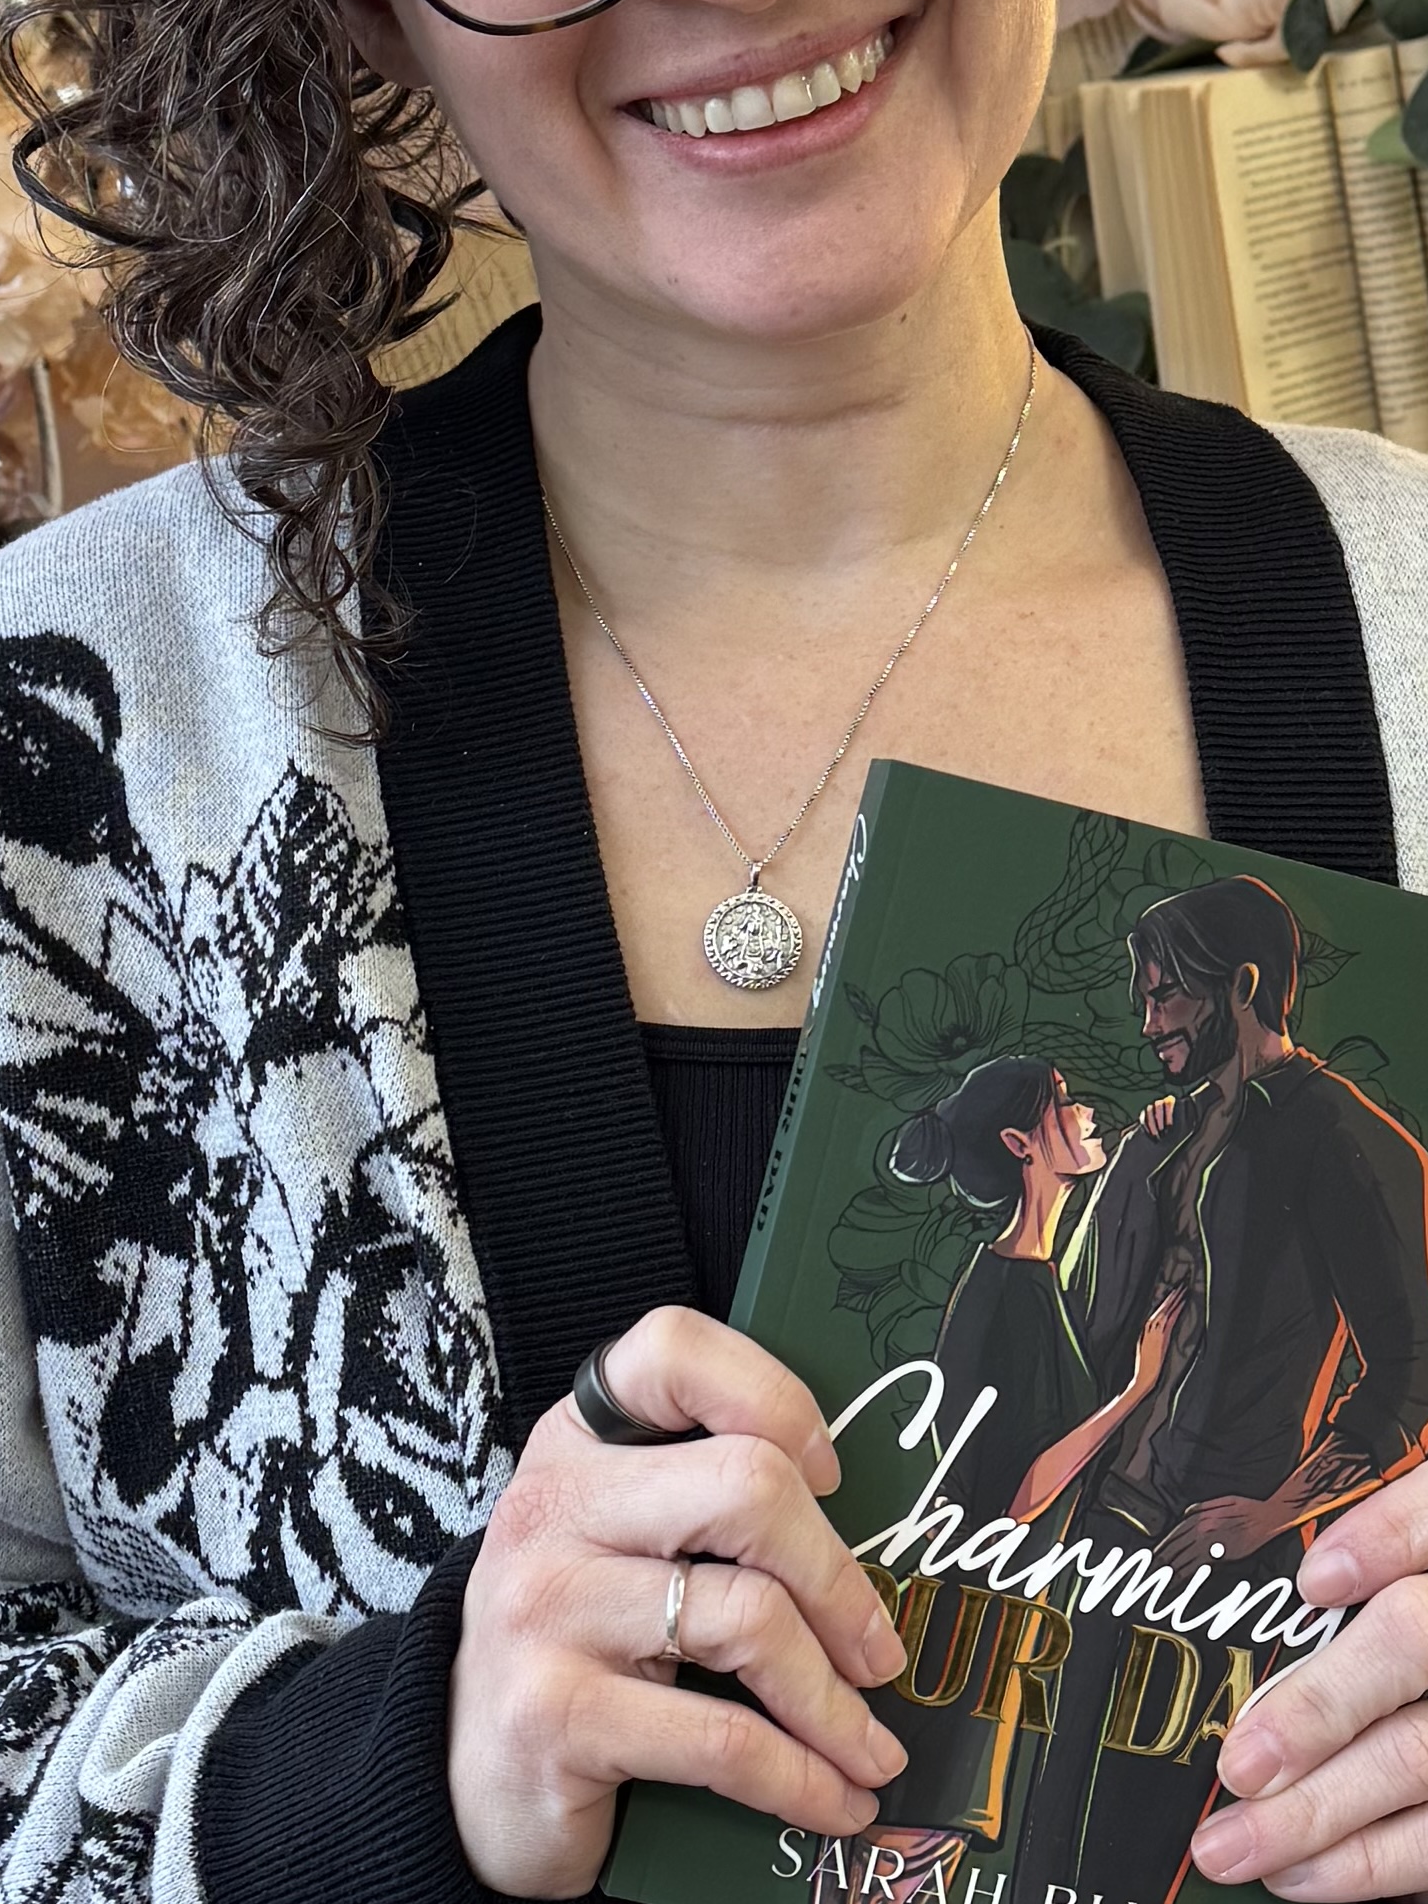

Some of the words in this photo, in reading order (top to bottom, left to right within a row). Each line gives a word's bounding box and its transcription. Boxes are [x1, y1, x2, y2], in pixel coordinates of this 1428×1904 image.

[828, 1359, 1348, 1724] Charming
[859, 1562, 1073, 1735] UR
[1101, 1623, 1257, 1766] DA
